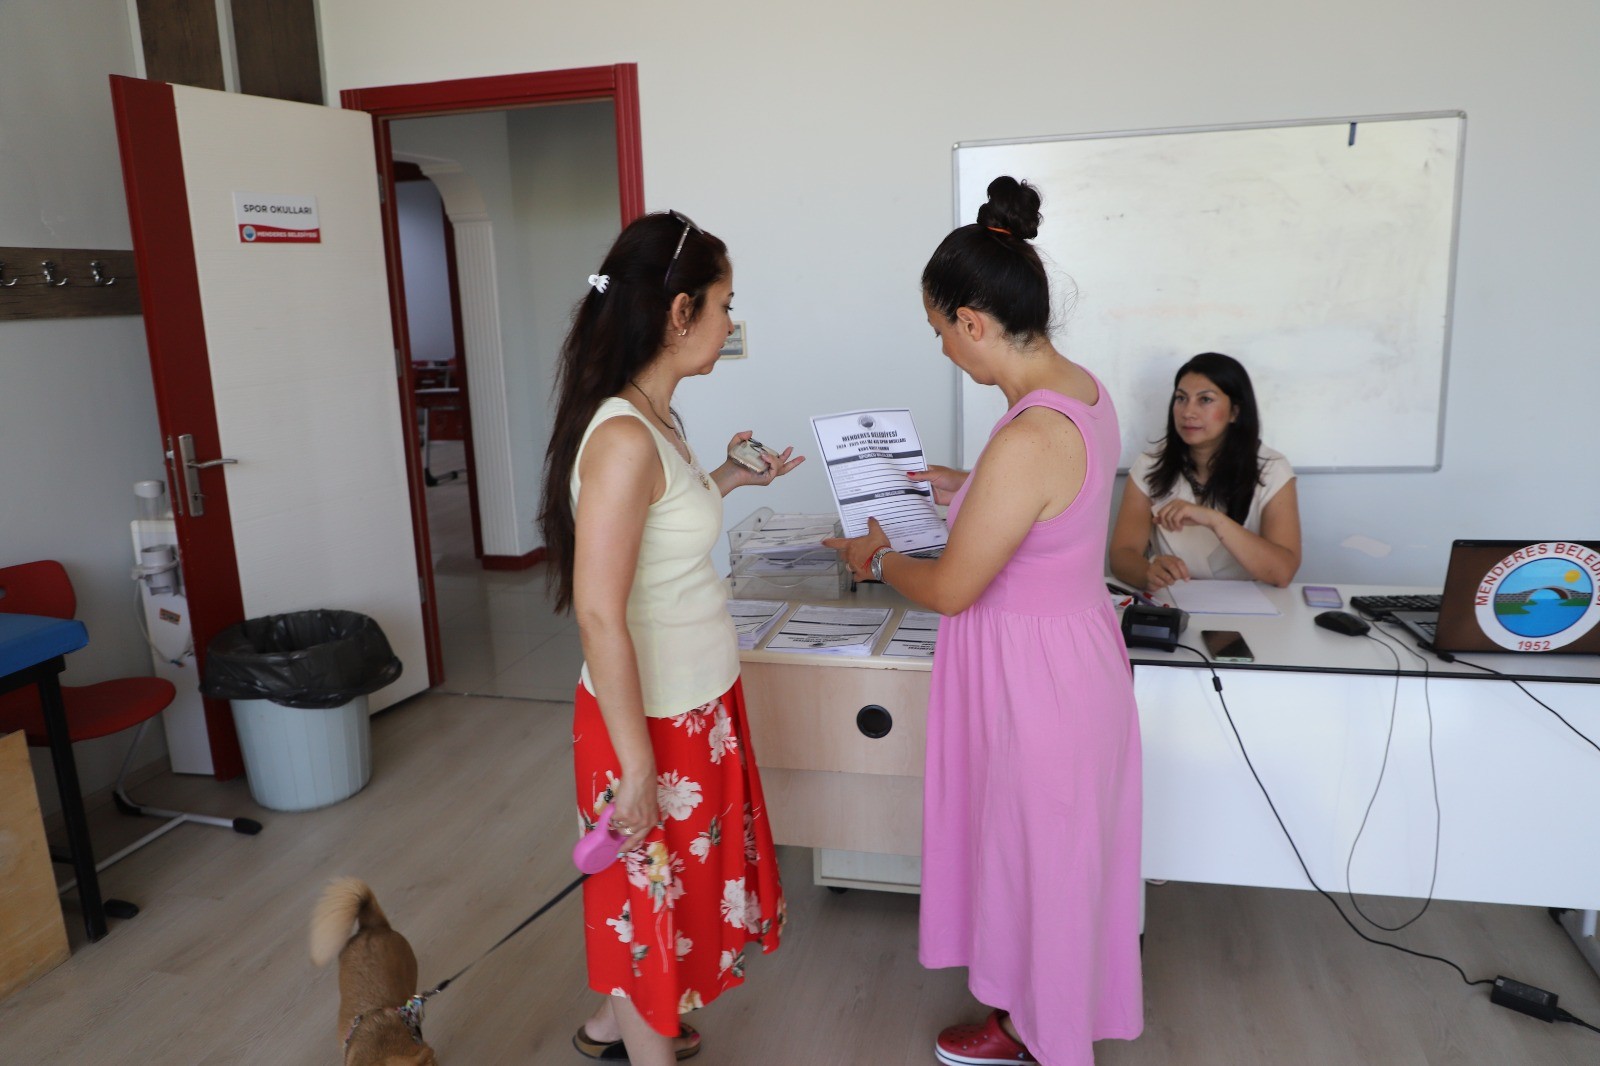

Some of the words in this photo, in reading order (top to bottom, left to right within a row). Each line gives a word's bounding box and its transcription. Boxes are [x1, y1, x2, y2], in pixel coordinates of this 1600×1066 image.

[243, 204, 267, 213] SPOR
[270, 206, 312, 215] OKULLARI
[1475, 543, 1548, 606] MENDERES
[1517, 640, 1551, 651] 1952
